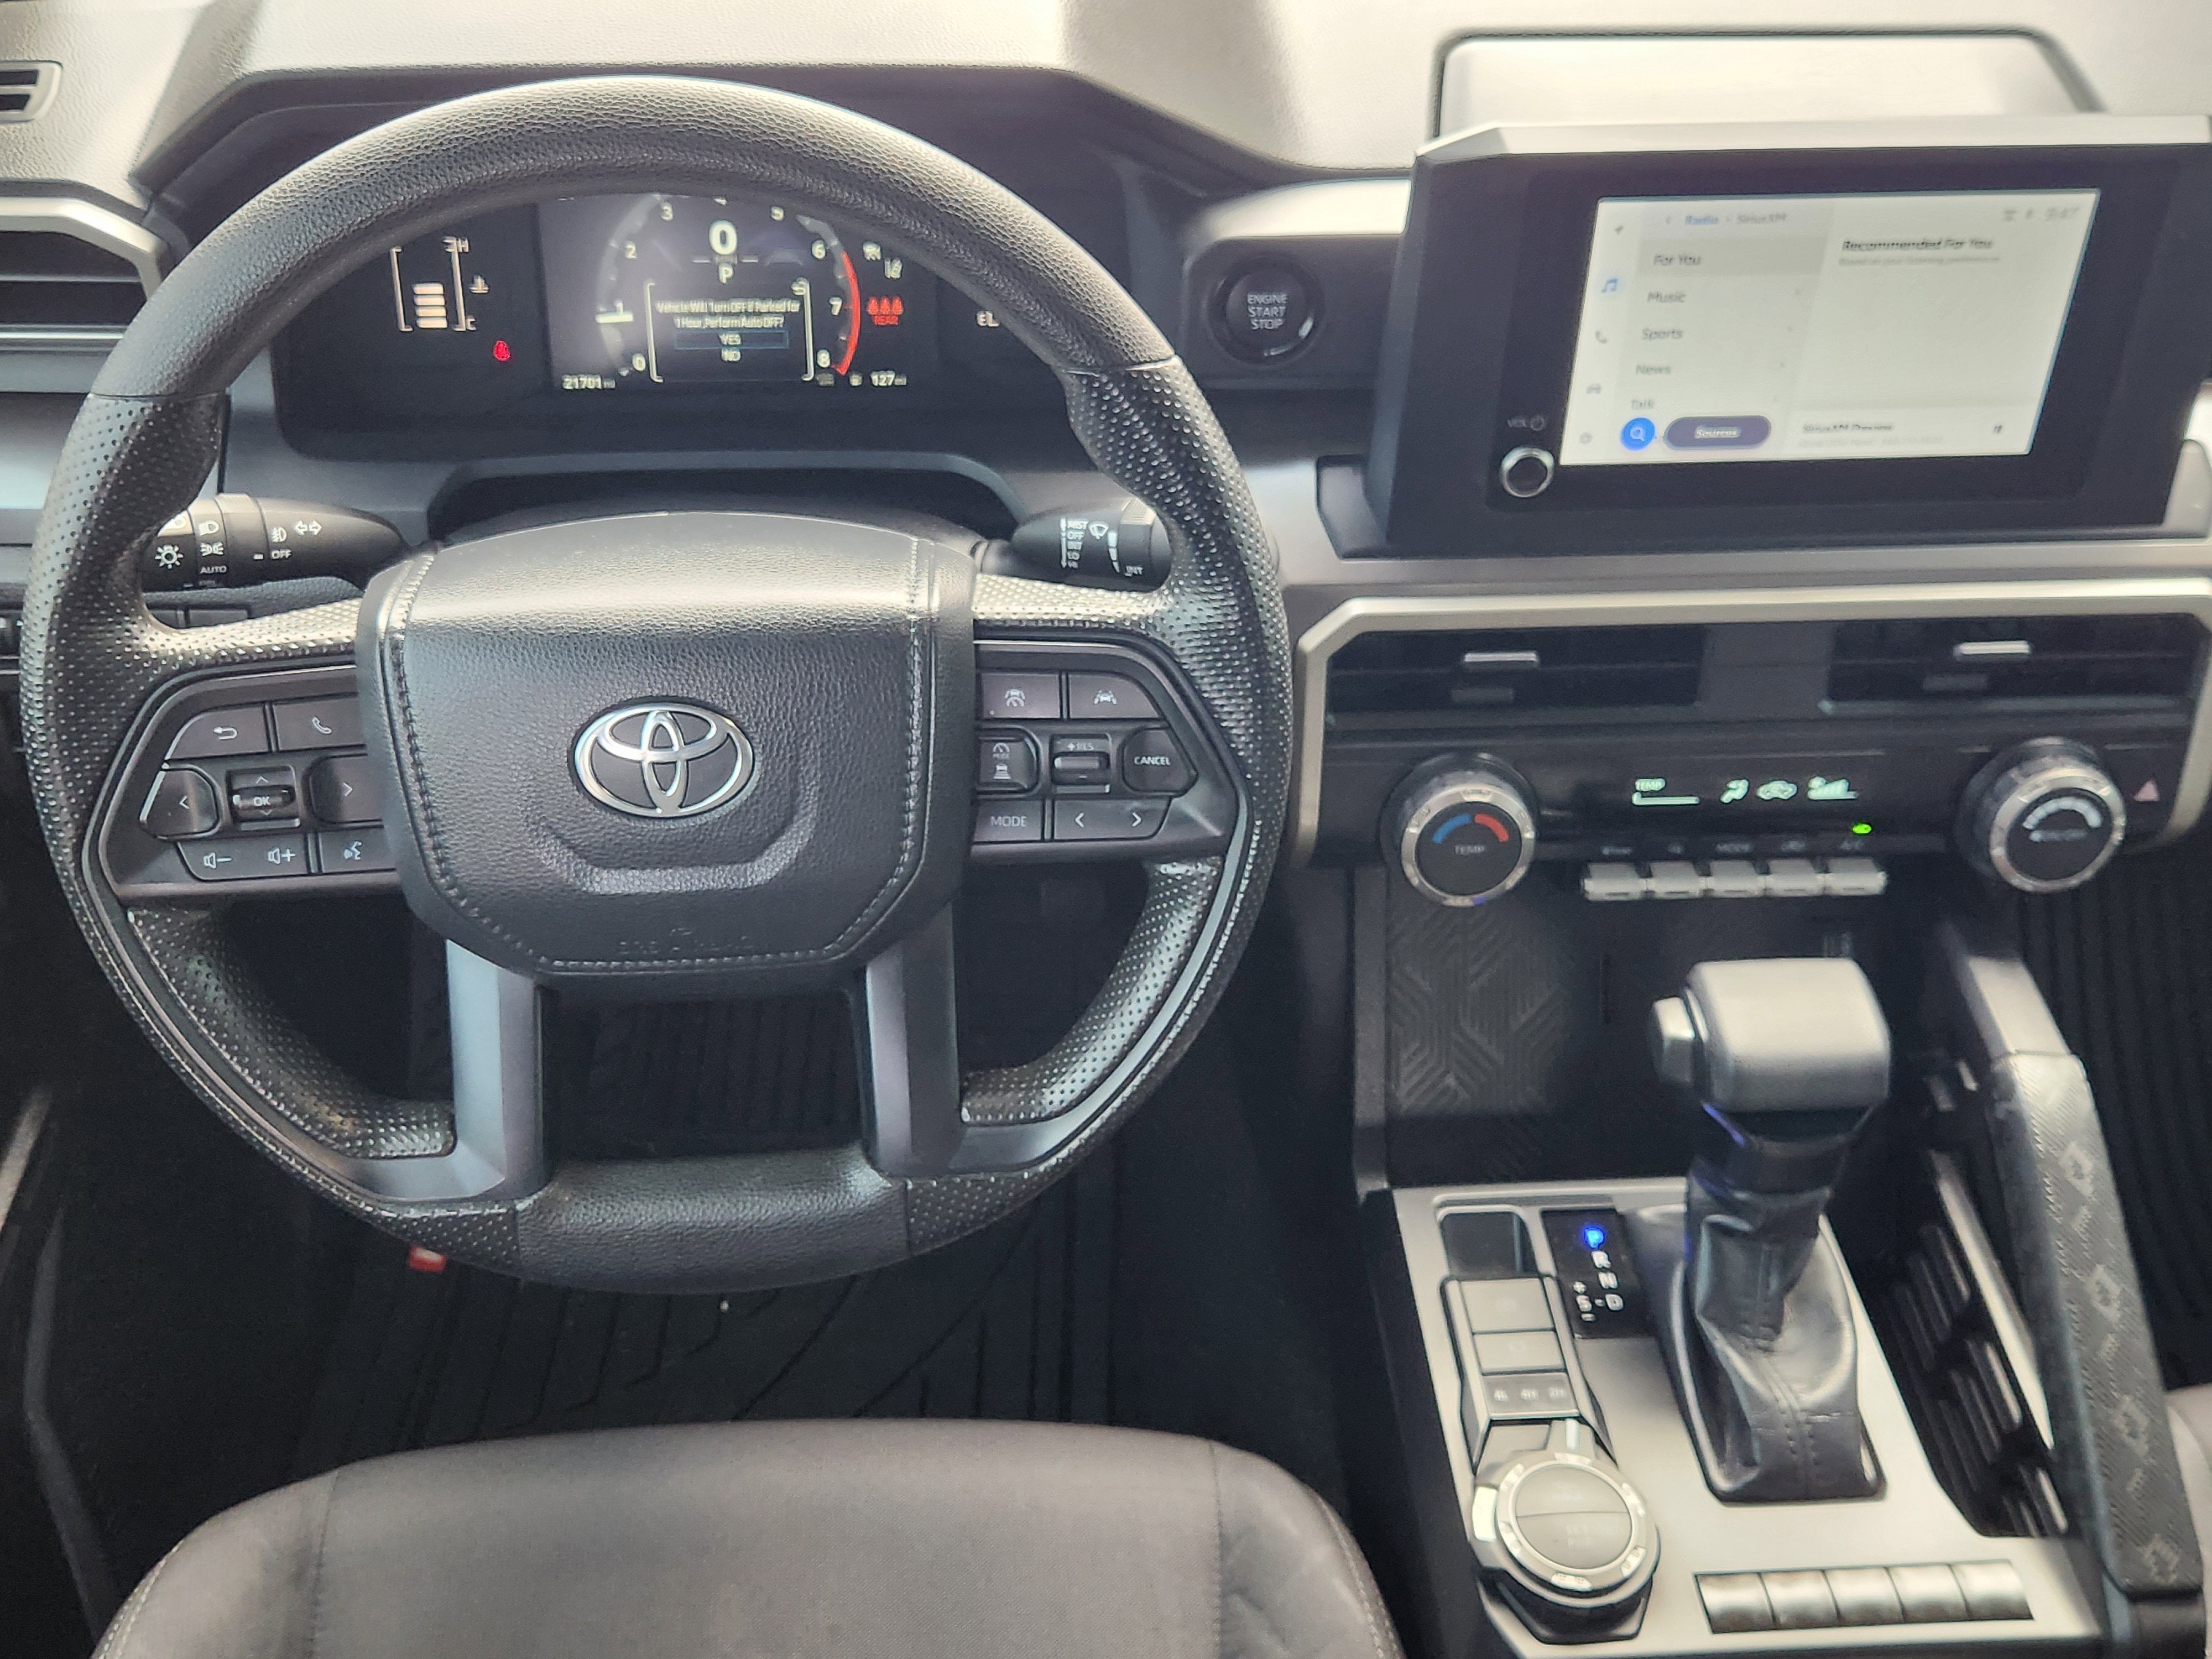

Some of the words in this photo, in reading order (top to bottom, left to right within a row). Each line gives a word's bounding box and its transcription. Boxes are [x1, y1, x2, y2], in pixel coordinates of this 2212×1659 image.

[661, 202, 674, 221] 3
[708, 220, 738, 255] 0
[624, 241, 638, 259] 2
[811, 239, 826, 260] 6
[1654, 255, 1675, 265] For
[1679, 254, 1702, 265] You
[719, 264, 733, 284] P
[1247, 293, 1287, 304] ENGINE
[1647, 291, 1687, 303] Music
[830, 296, 843, 316] 7
[1248, 306, 1286, 318] START
[1251, 319, 1284, 330] STOP
[719, 332, 742, 346] YES
[1641, 328, 1683, 340] Sports
[632, 353, 646, 372] 0
[816, 349, 831, 368] 8
[1635, 363, 1671, 375] News
[870, 371, 895, 387] 127
[1630, 399, 1655, 410] Talk
[1067, 530, 1085, 540] OFF
[271, 549, 293, 560] OFF
[199, 565, 228, 574] AUTO
[1134, 755, 1171, 766] CANCEL
[253, 795, 271, 807] OK
[990, 815, 1027, 828] MODE
